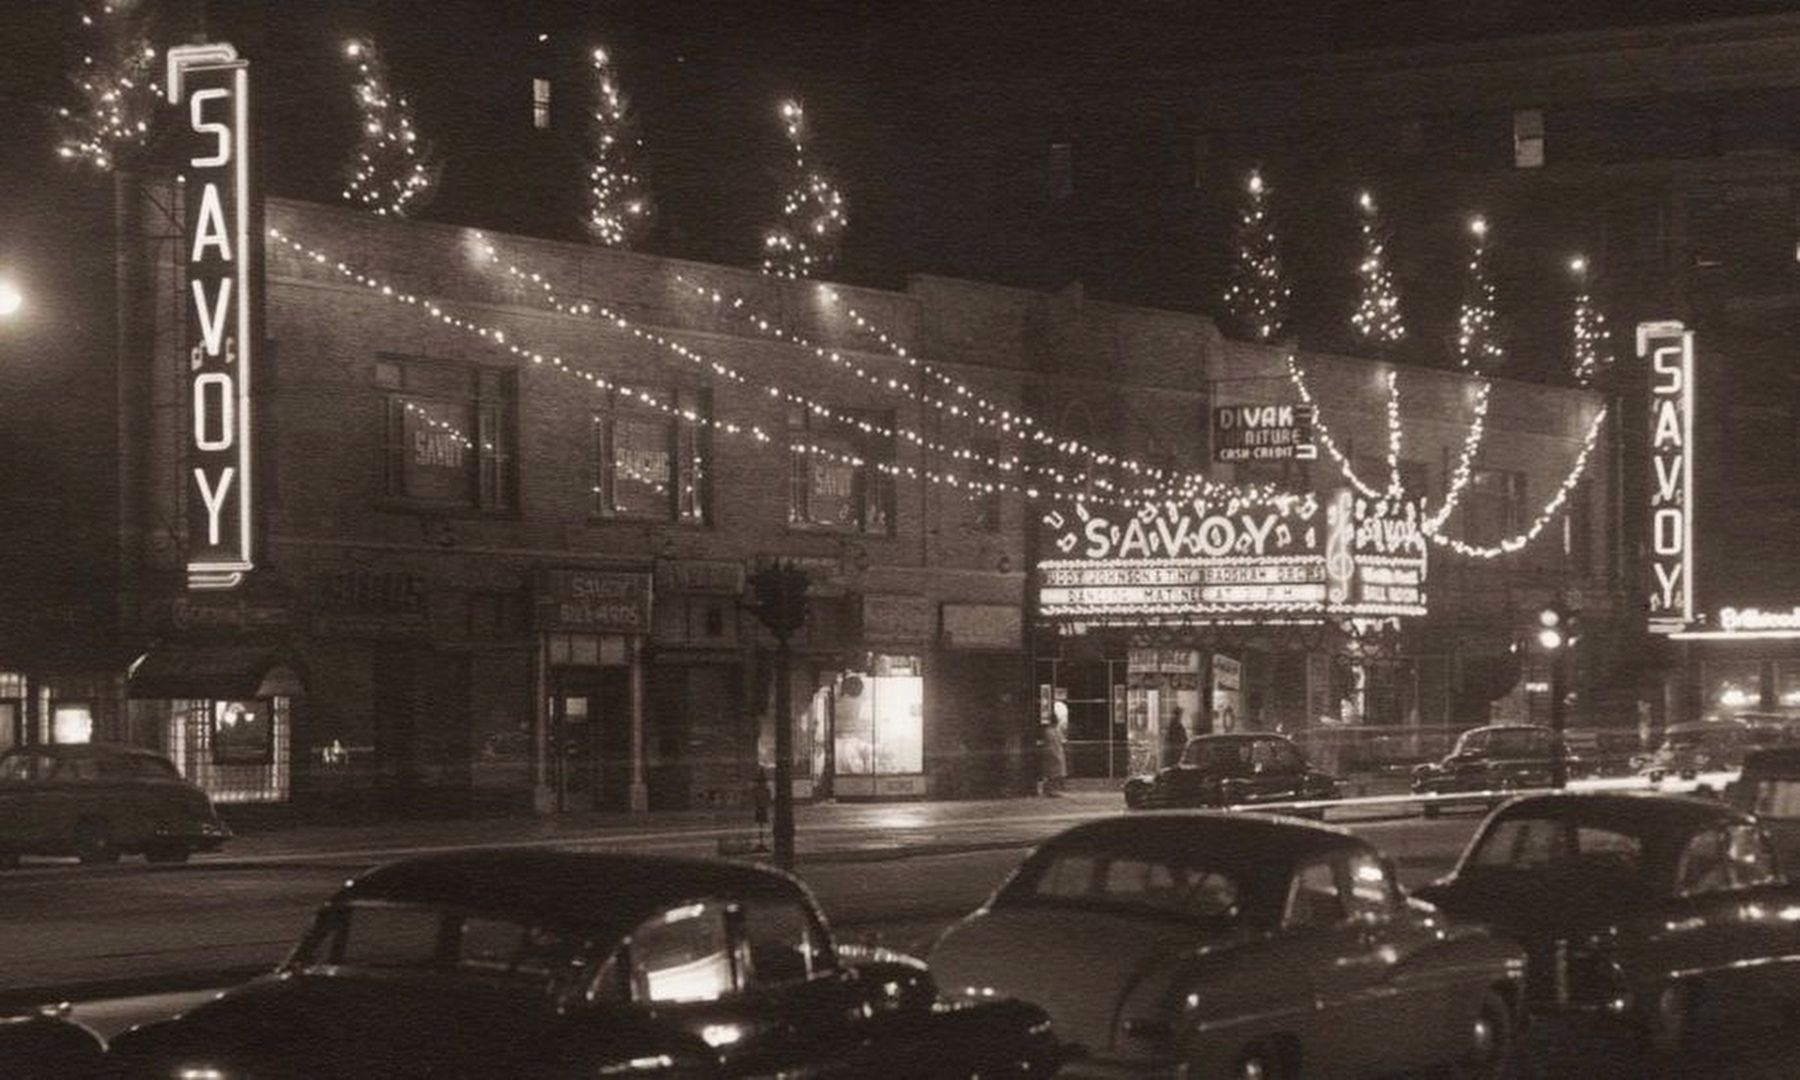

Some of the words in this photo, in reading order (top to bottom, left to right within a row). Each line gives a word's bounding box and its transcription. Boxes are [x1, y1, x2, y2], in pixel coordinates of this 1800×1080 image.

[191, 87, 235, 546] SAVOY
[1219, 447, 1250, 460] CASH
[1253, 445, 1294, 460] CREDIT
[1220, 428, 1302, 447] NITURE
[1652, 346, 1683, 609] SAVOY
[1084, 514, 1279, 558] SAVOY
[1144, 588, 1204, 602] MATINEE
